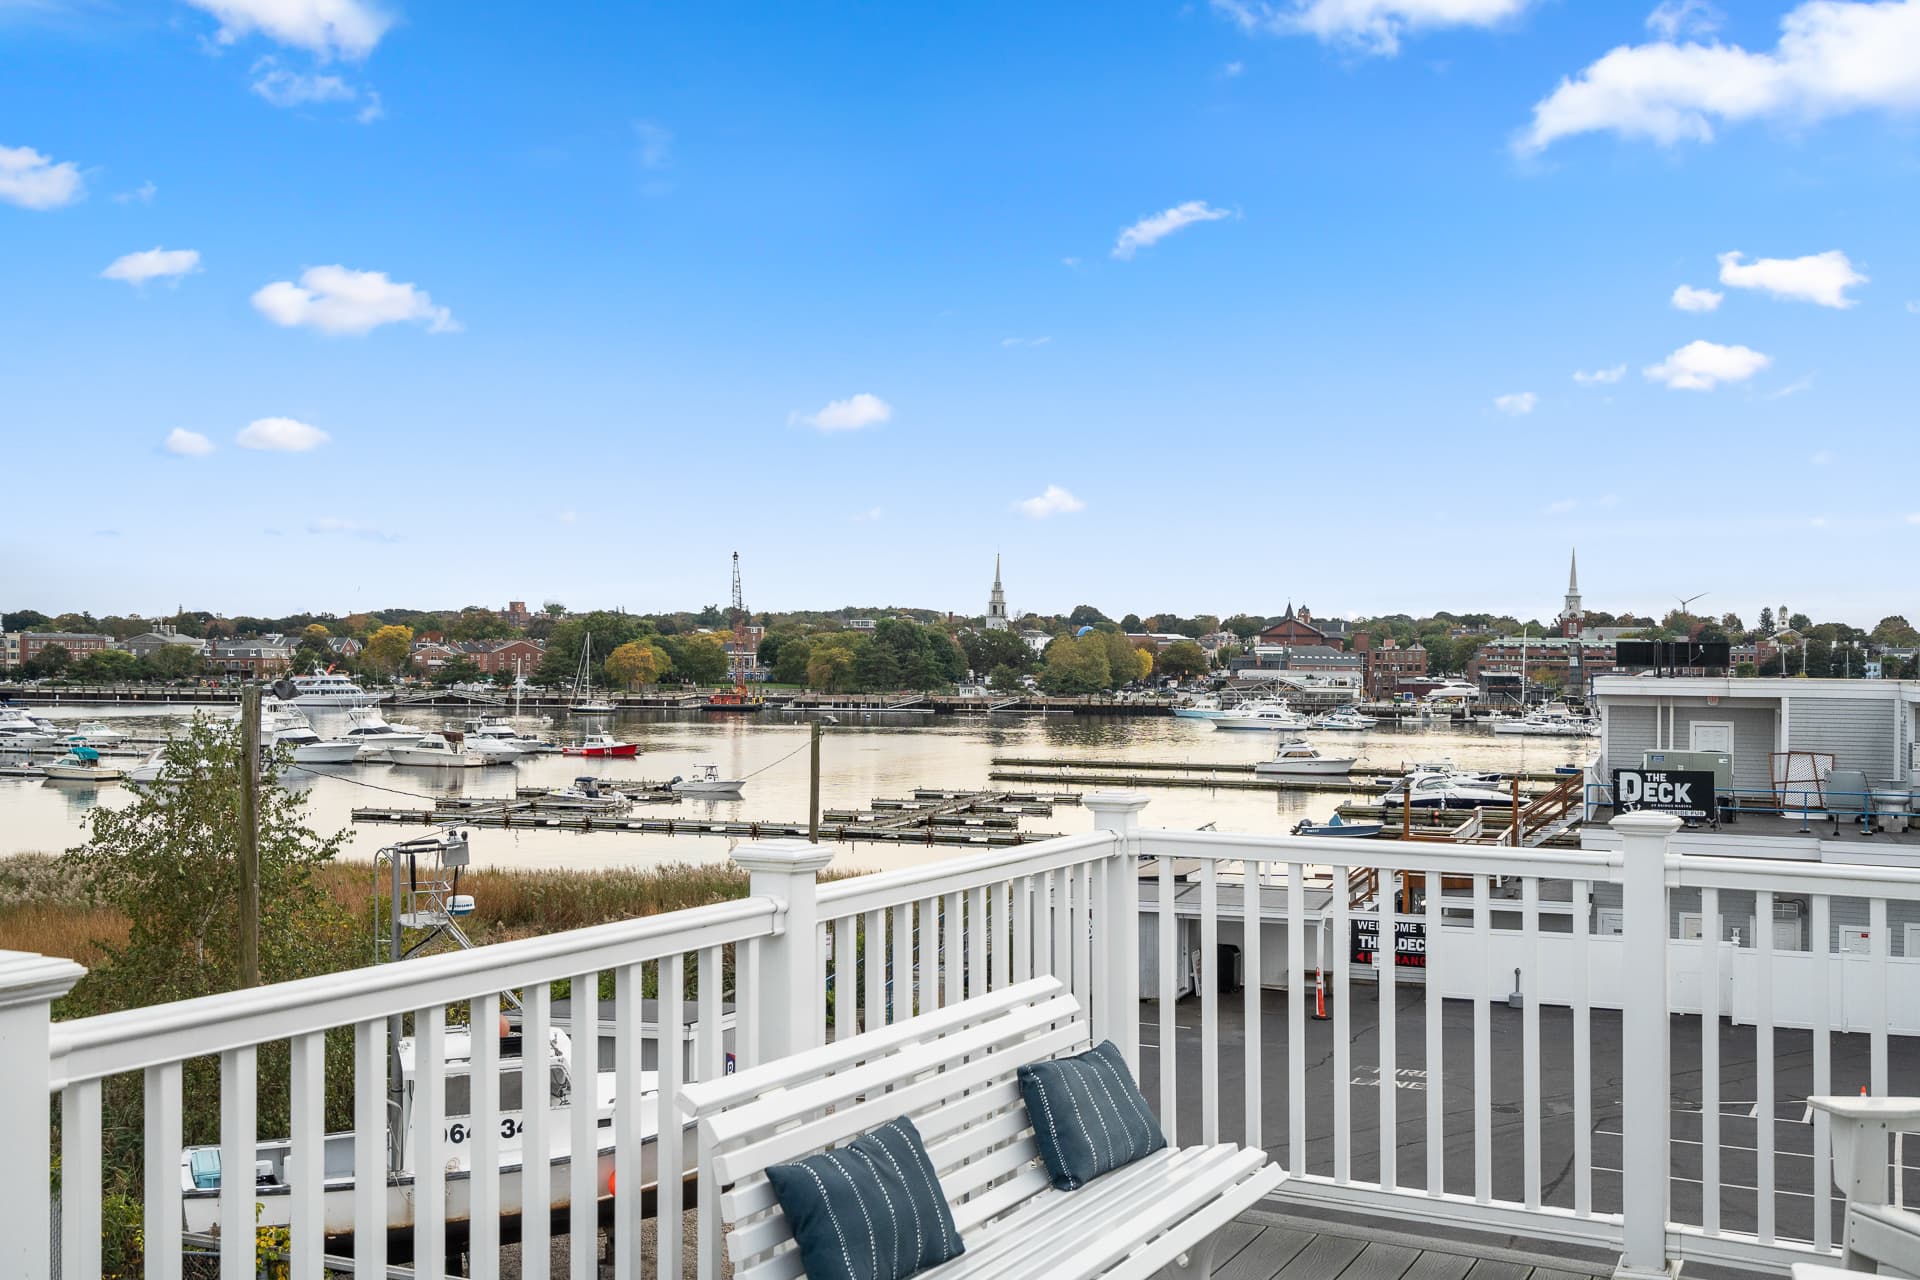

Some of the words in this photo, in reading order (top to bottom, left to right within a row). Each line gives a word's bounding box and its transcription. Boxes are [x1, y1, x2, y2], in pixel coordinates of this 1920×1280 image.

[1645, 773, 1667, 782] THE
[1620, 772, 1691, 802] DECK
[1357, 921, 1416, 933] WELOME
[1398, 937, 1425, 952] DEC
